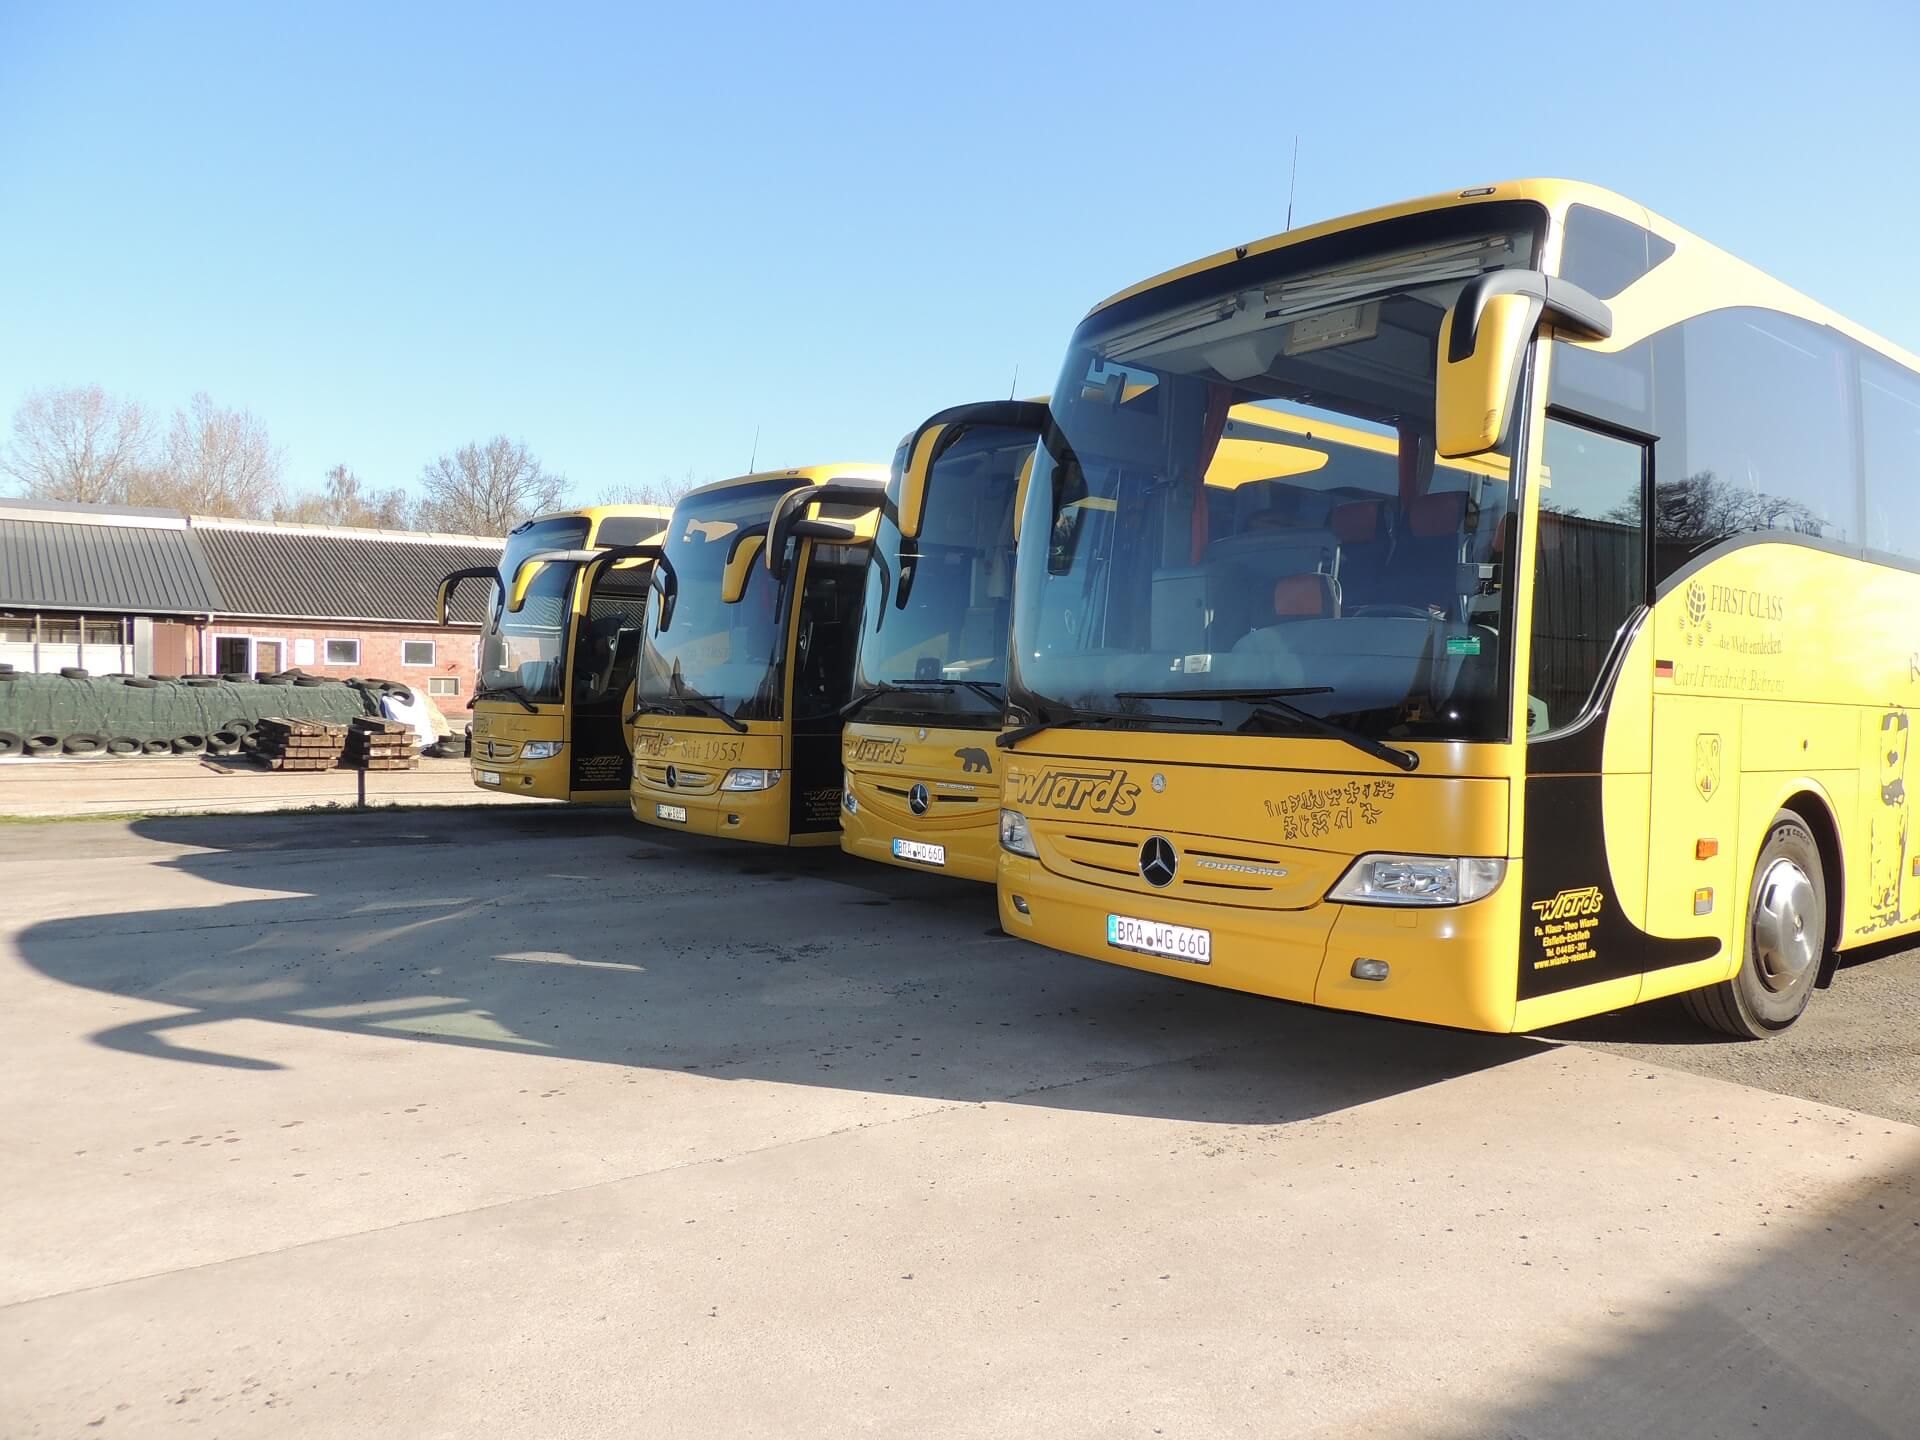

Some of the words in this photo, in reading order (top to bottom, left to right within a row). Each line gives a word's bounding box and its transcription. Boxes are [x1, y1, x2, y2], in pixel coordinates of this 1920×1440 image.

[1711, 584, 1747, 616] FIRST
[1748, 591, 1783, 622] CLASS
[682, 739, 701, 760] Seit
[704, 740, 745, 762] 1955!
[1007, 764, 1142, 816] Wiards
[1197, 860, 1288, 877] TOURISMO
[1532, 886, 1603, 921] Wiards
[1118, 921, 1143, 945] BRA
[1156, 928, 1173, 950] WG
[1178, 932, 1206, 956] 660
